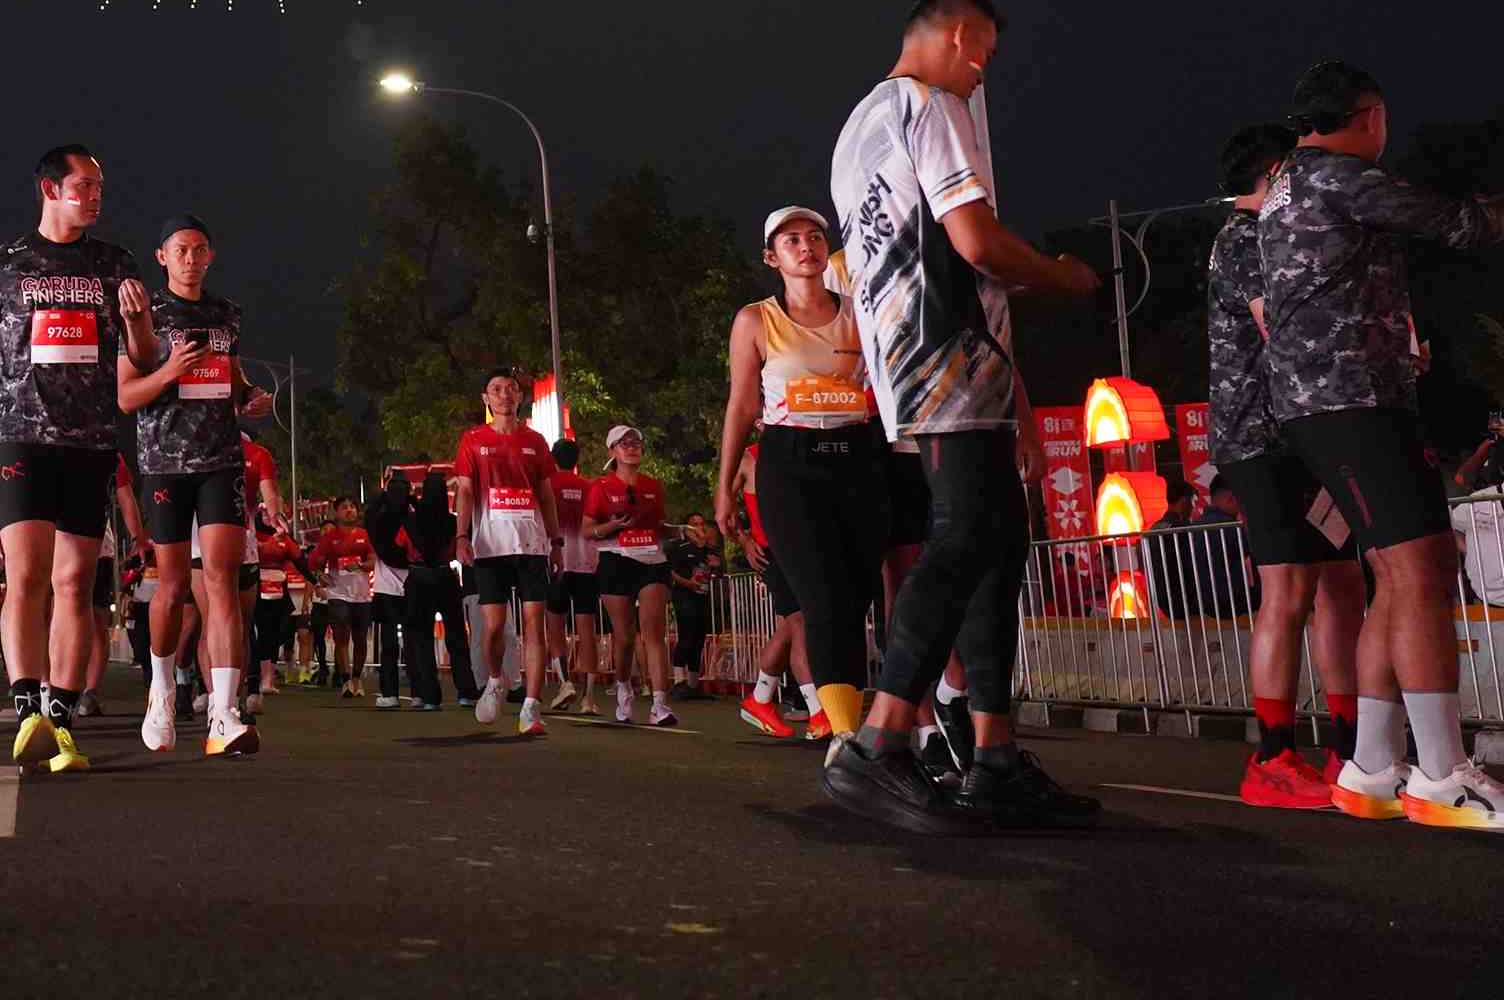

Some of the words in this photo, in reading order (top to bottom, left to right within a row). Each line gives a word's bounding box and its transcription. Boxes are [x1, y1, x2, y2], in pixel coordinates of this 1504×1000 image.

[21, 275, 102, 292] GARUDA
[22, 289, 104, 305] FINISHERS
[47, 326, 84, 338] 97628
[811, 441, 849, 453] JETE
